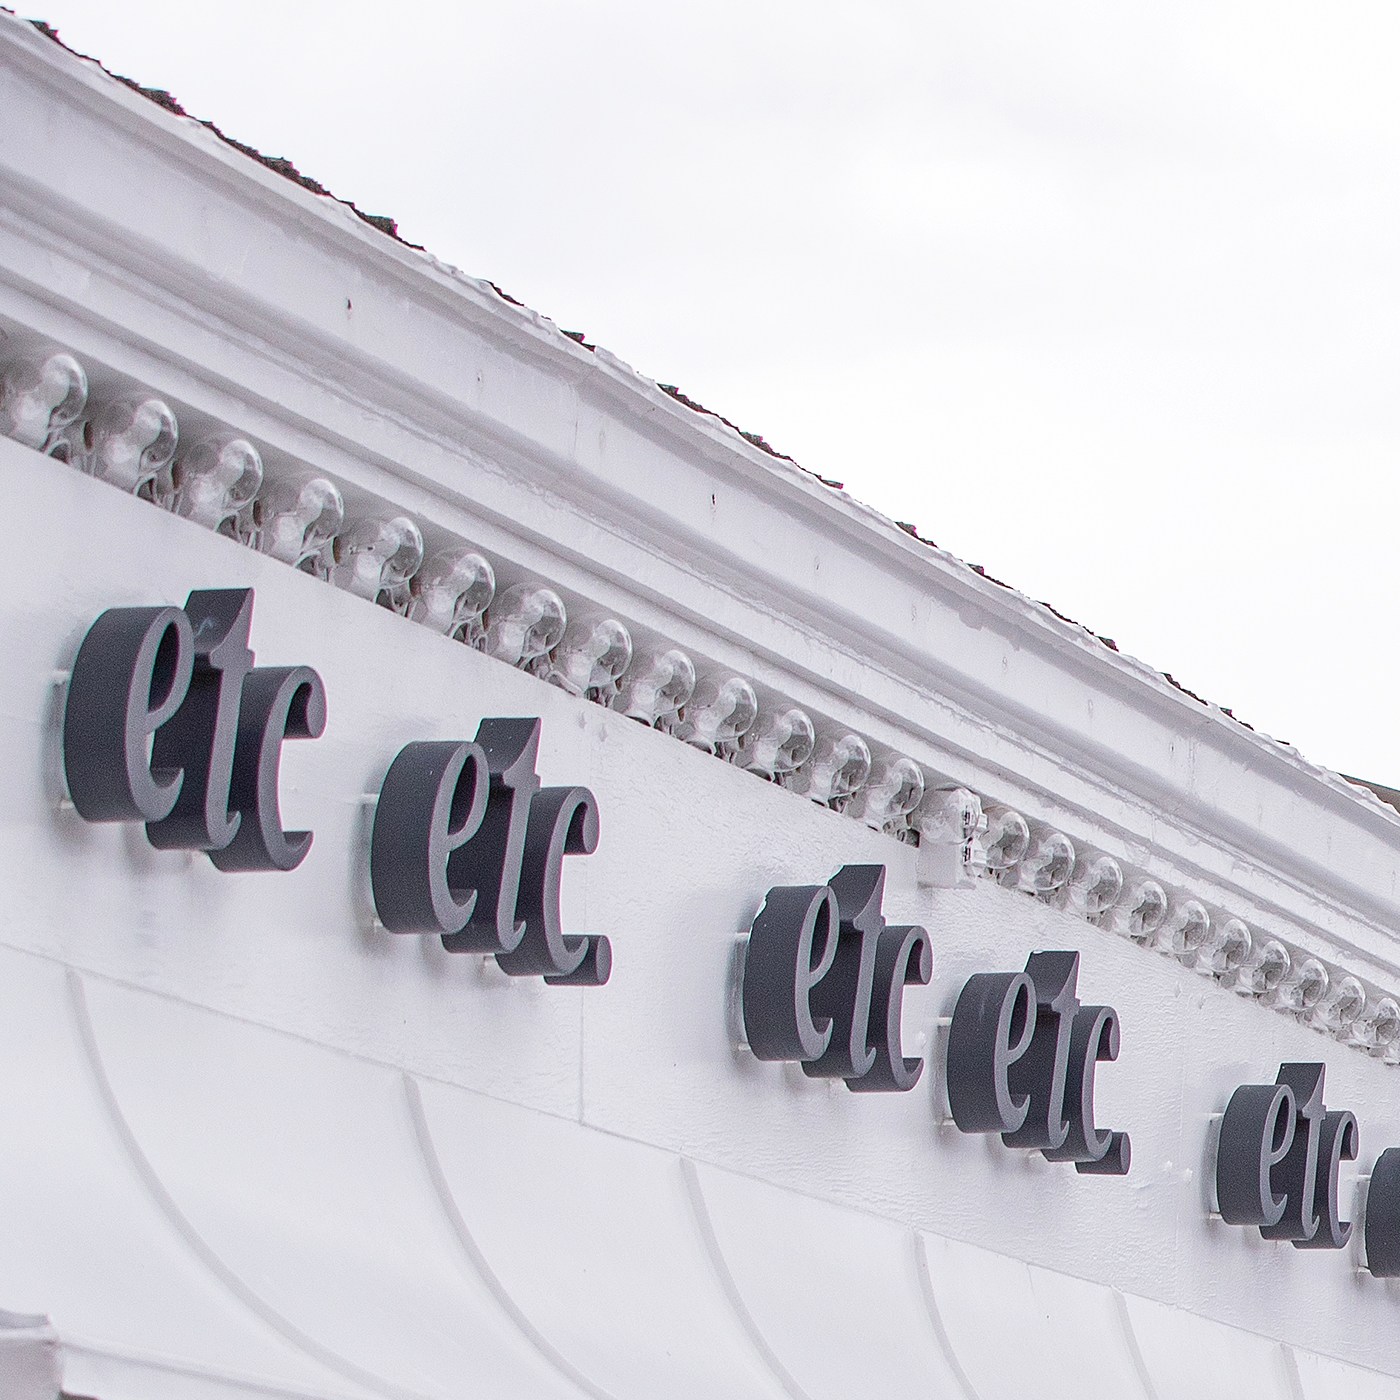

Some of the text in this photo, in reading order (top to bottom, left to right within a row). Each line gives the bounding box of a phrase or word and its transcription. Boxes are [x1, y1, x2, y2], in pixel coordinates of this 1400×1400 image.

[65, 588, 327, 871] etc
[744, 865, 932, 1092] etc
[1217, 1063, 1358, 1249] etc
